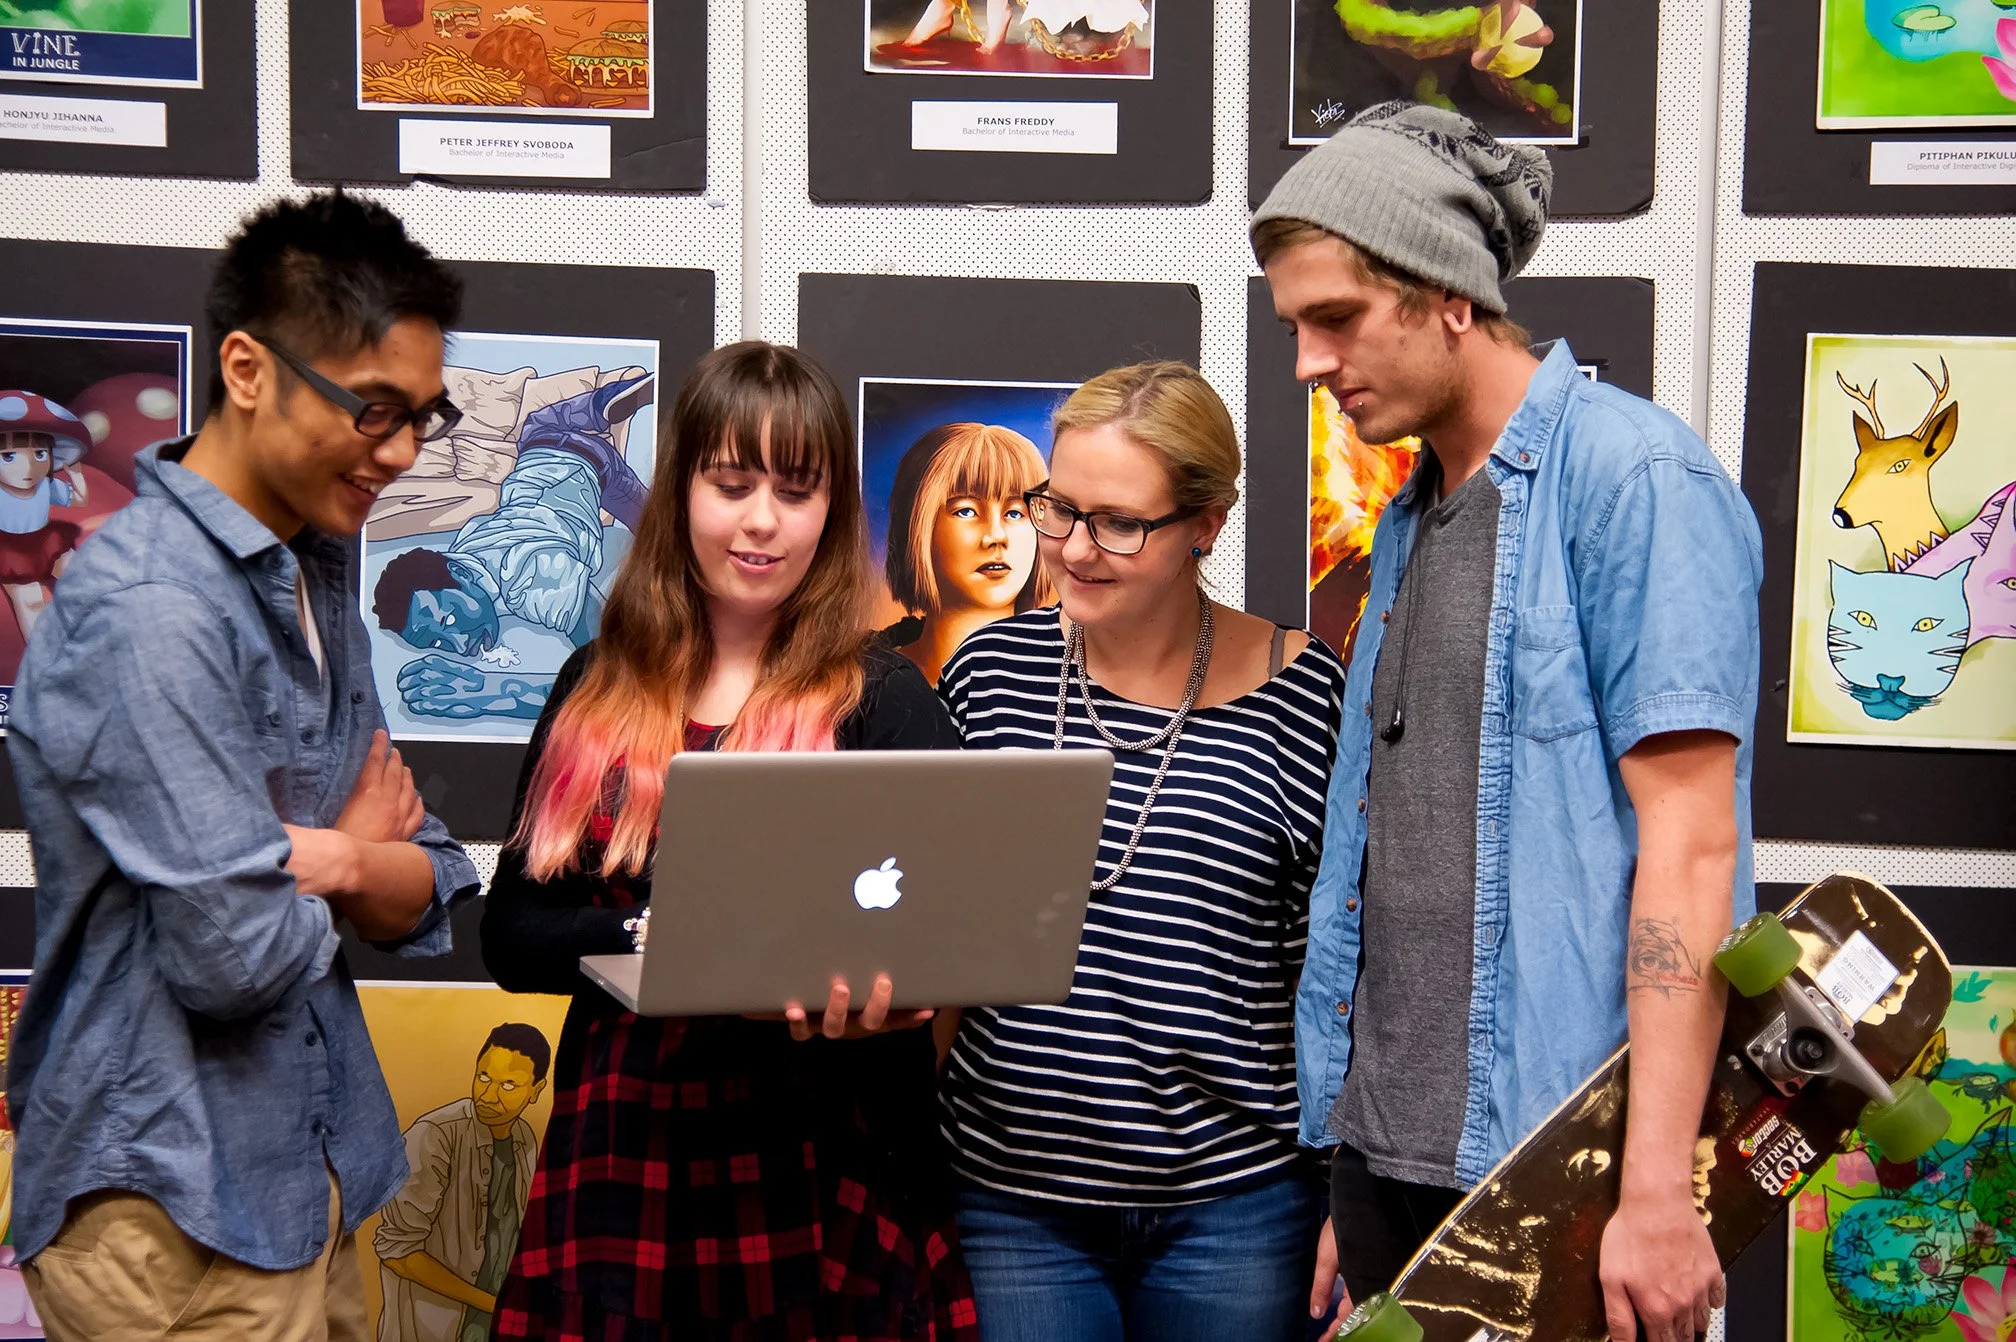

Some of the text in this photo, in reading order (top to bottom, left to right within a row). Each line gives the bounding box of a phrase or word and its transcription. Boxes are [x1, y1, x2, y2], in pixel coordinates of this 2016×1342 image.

[11, 31, 81, 57] VINE
[12, 56, 80, 71] IN JUNGLE
[3, 109, 104, 123] HONJYU JIHANNA
[977, 117, 1055, 126] FRANS FREDDY
[31, 122, 40, 130] of
[42, 123, 88, 133] Interactive
[90, 125, 115, 134] Media
[962, 127, 1075, 137] Bachelor of Interactive Media
[439, 137, 574, 150] PETER JEFFREY SVOBODA
[449, 148, 565, 160] Bachelor of Interactive Media
[1919, 152, 1973, 161] PITIPHAN
[1906, 163, 1940, 171] Diploma
[1842, 957, 1875, 992] WARNING
[1750, 1126, 1803, 1182] MARLEY
[1761, 1138, 1818, 1196] BOB
